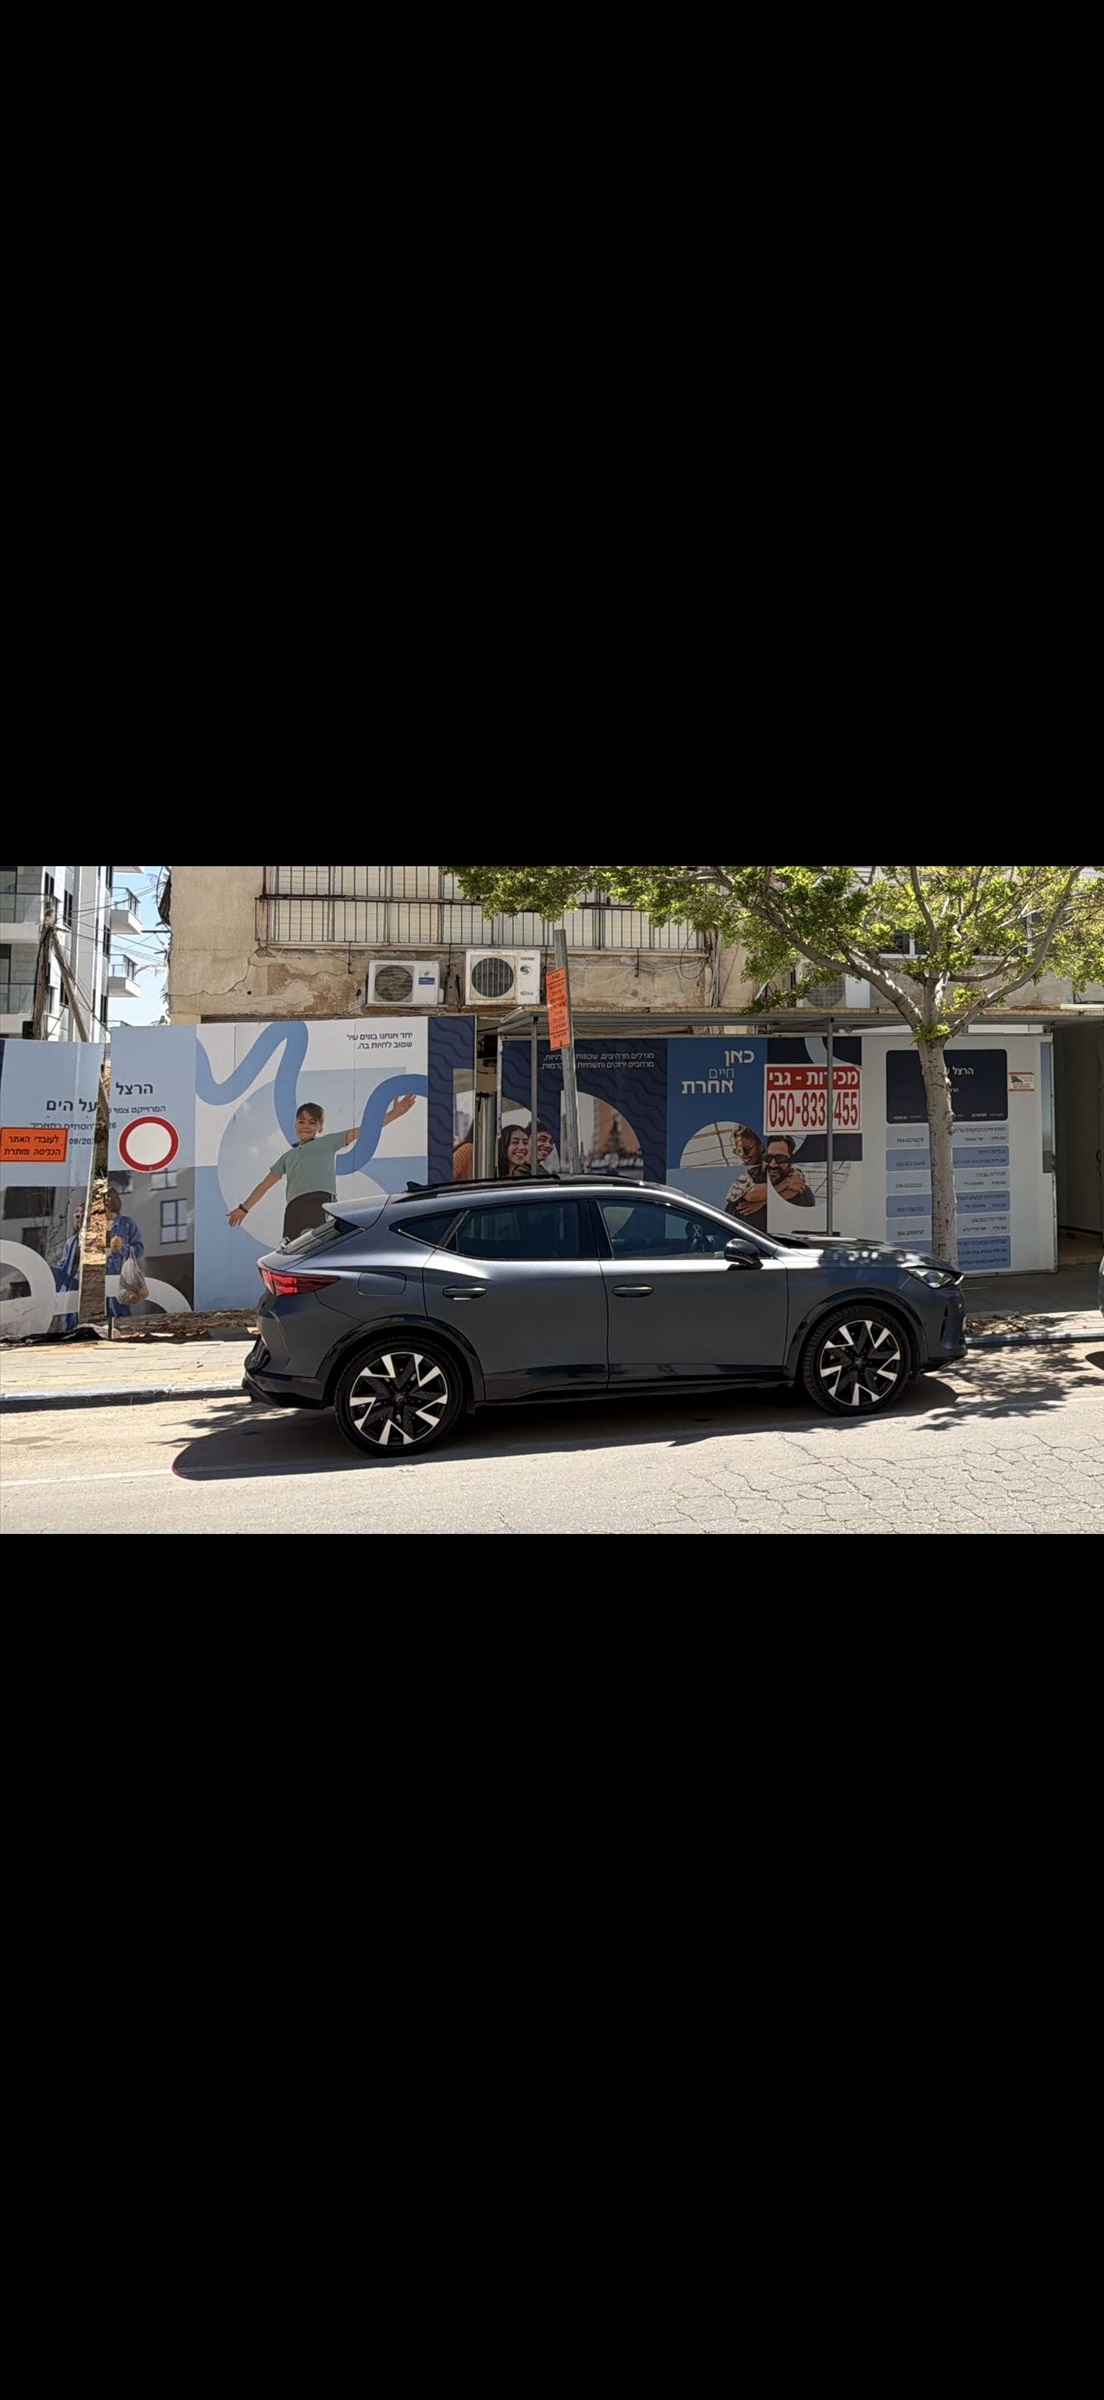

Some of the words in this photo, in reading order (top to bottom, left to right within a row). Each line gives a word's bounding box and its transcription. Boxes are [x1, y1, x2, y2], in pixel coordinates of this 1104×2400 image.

[371, 1041, 392, 1049] לחיות
[724, 1050, 755, 1067] כאן
[708, 1068, 734, 1079] חיים
[952, 1066, 974, 1075] הרצל
[769, 1072, 791, 1086] גבי
[806, 1071, 858, 1085] מכיות
[115, 1082, 154, 1095] הרצל
[681, 1080, 734, 1094] אחרת
[46, 1100, 74, 1112] הים
[79, 1098, 98, 1113] על
[769, 1092, 858, 1127] 050-833455
[8, 1136, 30, 1144] האתר
[34, 1135, 59, 1144] לעובדי
[33, 1148, 61, 1156] הכניסה
